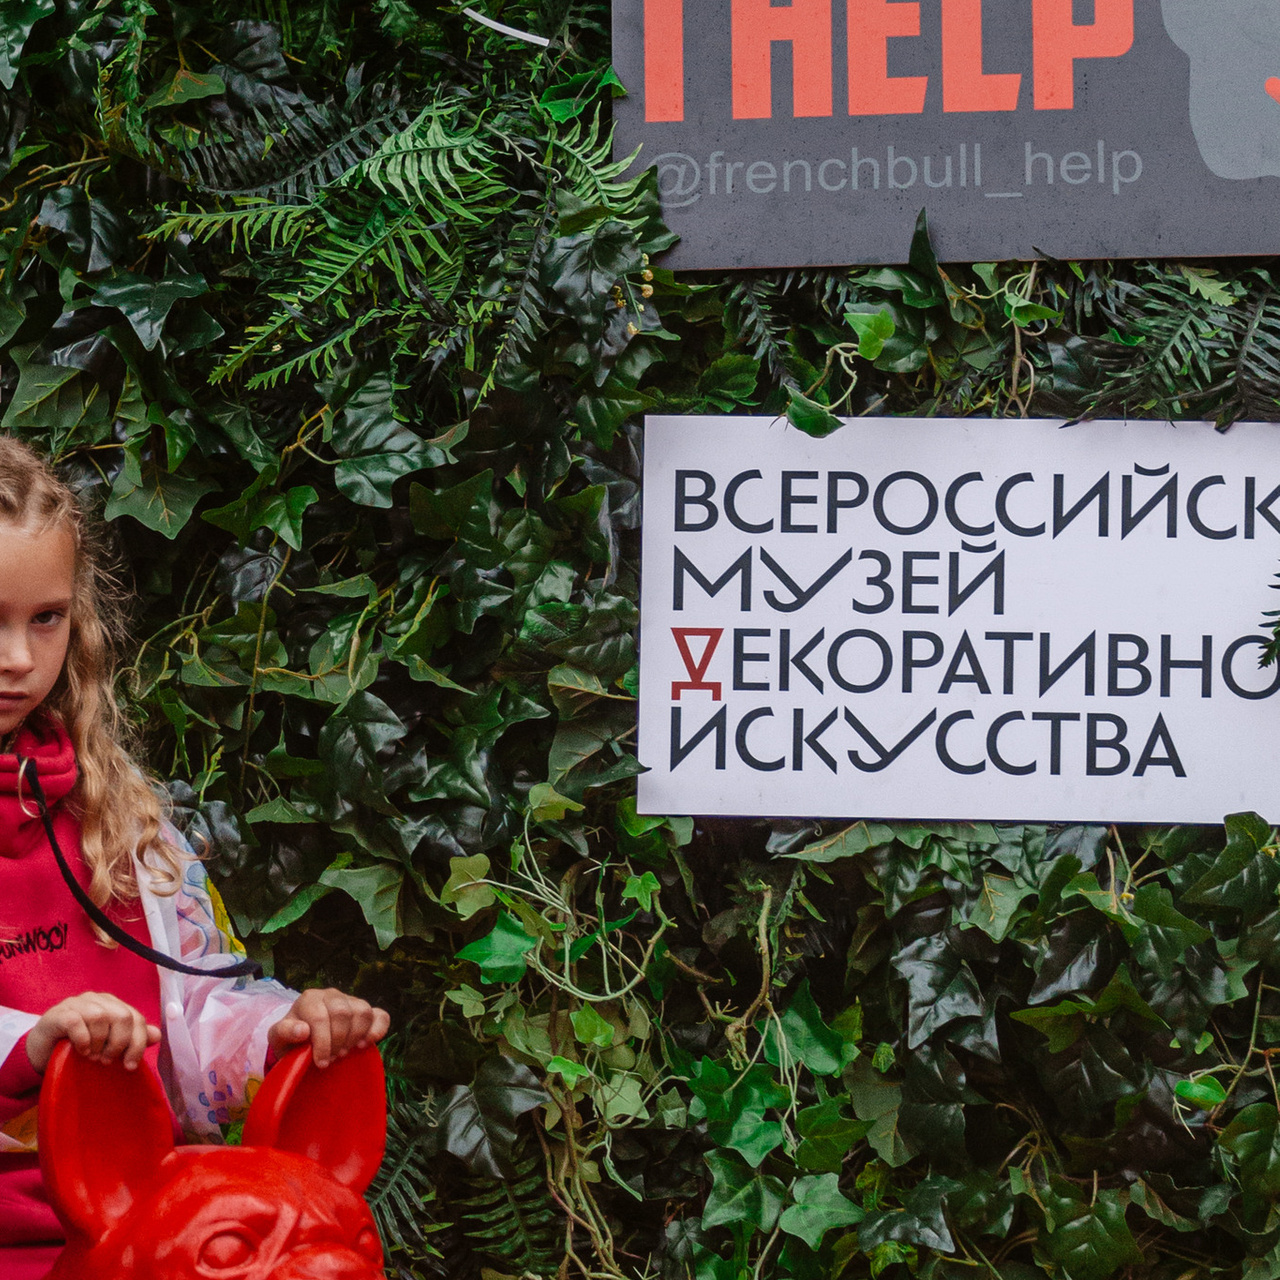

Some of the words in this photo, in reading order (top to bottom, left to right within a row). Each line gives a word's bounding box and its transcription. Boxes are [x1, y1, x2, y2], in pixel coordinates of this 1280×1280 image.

[646, 140, 1144, 208] @frenchbull_help
[674, 463, 1280, 541] ВСЕРОССИЙСК
[673, 540, 1006, 617] МУЗЕЙ
[671, 627, 1280, 701] ДЕКОРАТИВНО
[670, 704, 1188, 778] ИСКУССТВА
